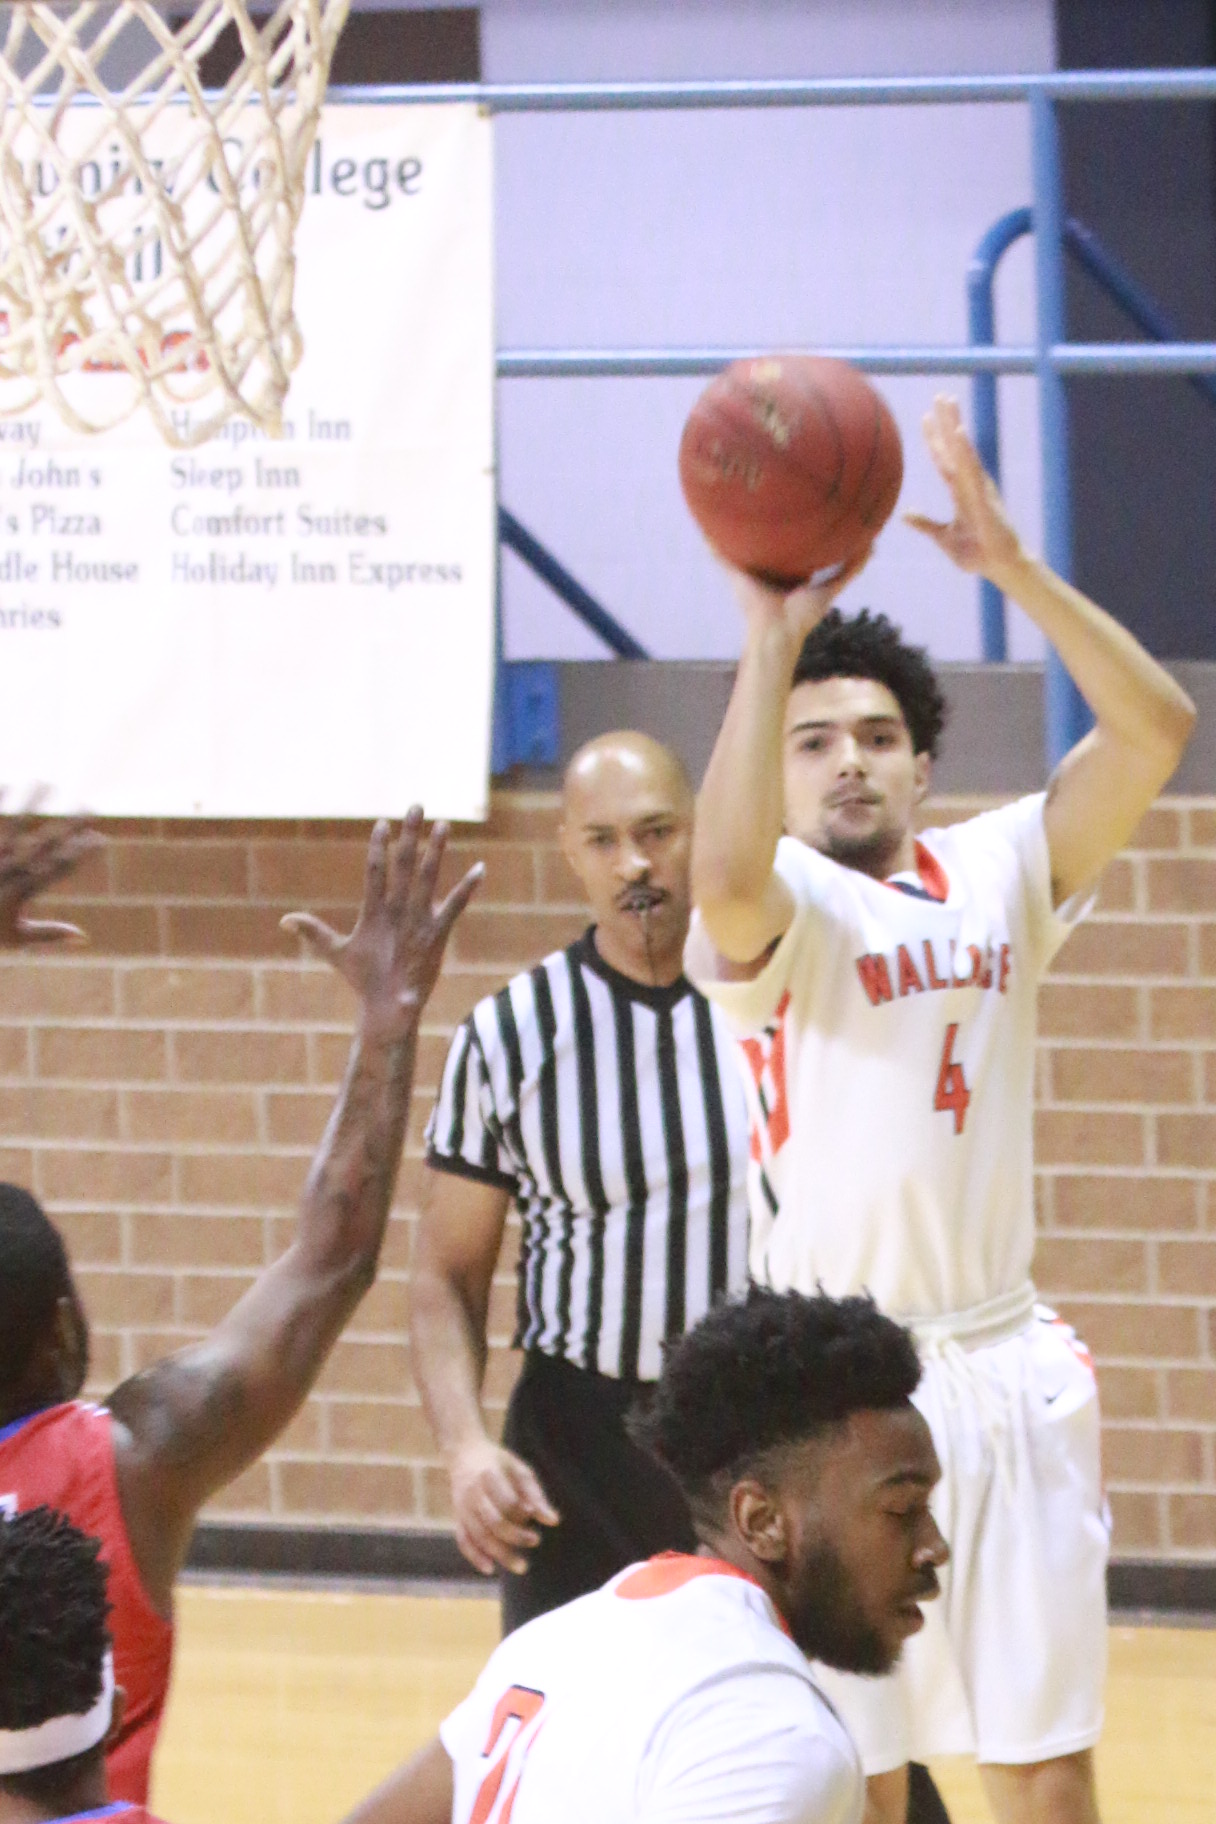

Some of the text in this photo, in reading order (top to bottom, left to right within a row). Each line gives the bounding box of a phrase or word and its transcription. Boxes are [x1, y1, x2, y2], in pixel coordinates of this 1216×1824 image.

[206, 136, 424, 210] Clege
[171, 409, 352, 447] Hmpn Inn
[10, 456, 103, 490] Johns
[170, 454, 302, 494] Sleep Inn
[30, 502, 104, 538] Pizza
[170, 503, 388, 539] Comfort Suites
[51, 550, 140, 585] House
[171, 551, 464, 591] Holiday Inn Express
[855, 938, 1011, 1007] WALE
[933, 1022, 972, 1135] 4
